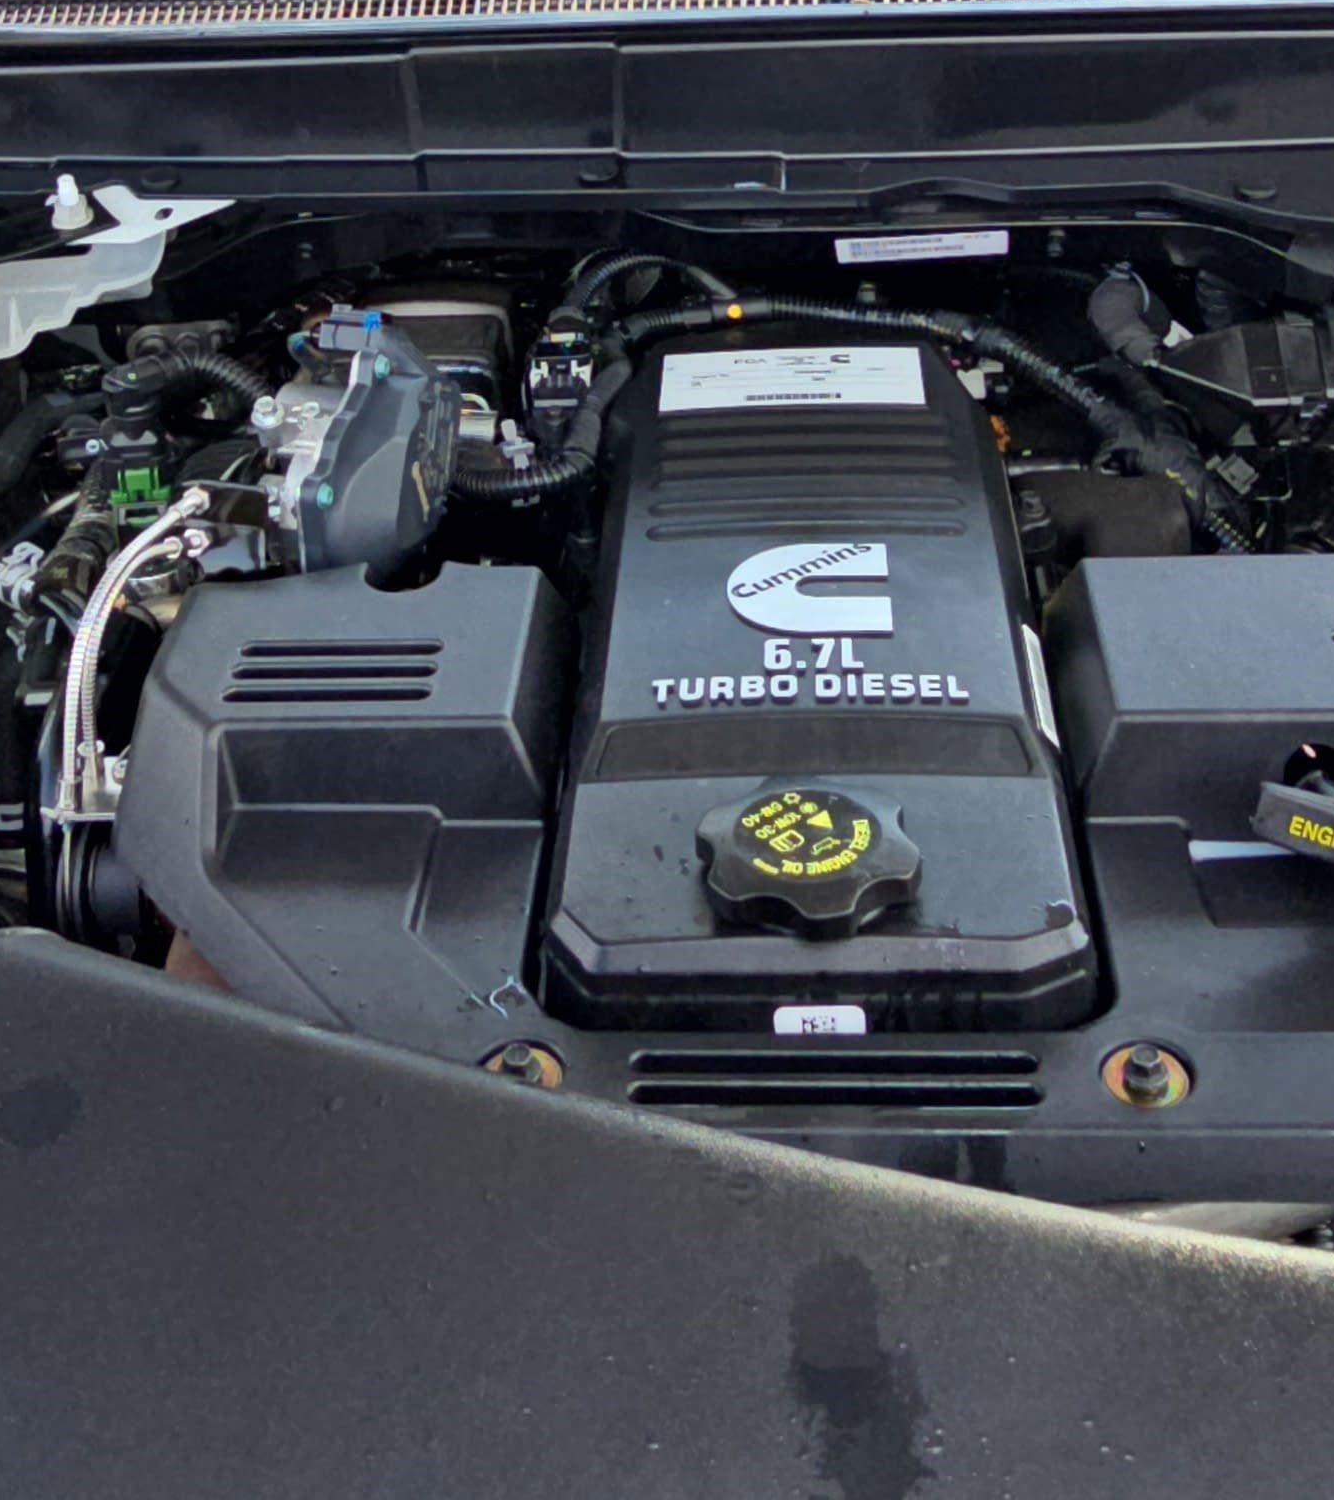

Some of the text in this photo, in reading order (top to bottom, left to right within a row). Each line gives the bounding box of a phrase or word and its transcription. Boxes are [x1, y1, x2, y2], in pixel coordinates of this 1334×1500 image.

[731, 543, 873, 599] Cummins
[763, 637, 865, 672] 6.7L
[652, 673, 970, 707] TURBO DIESEL
[754, 812, 802, 839] 10W-30
[782, 859, 804, 875] OIL
[806, 849, 858, 875] ENGINE
